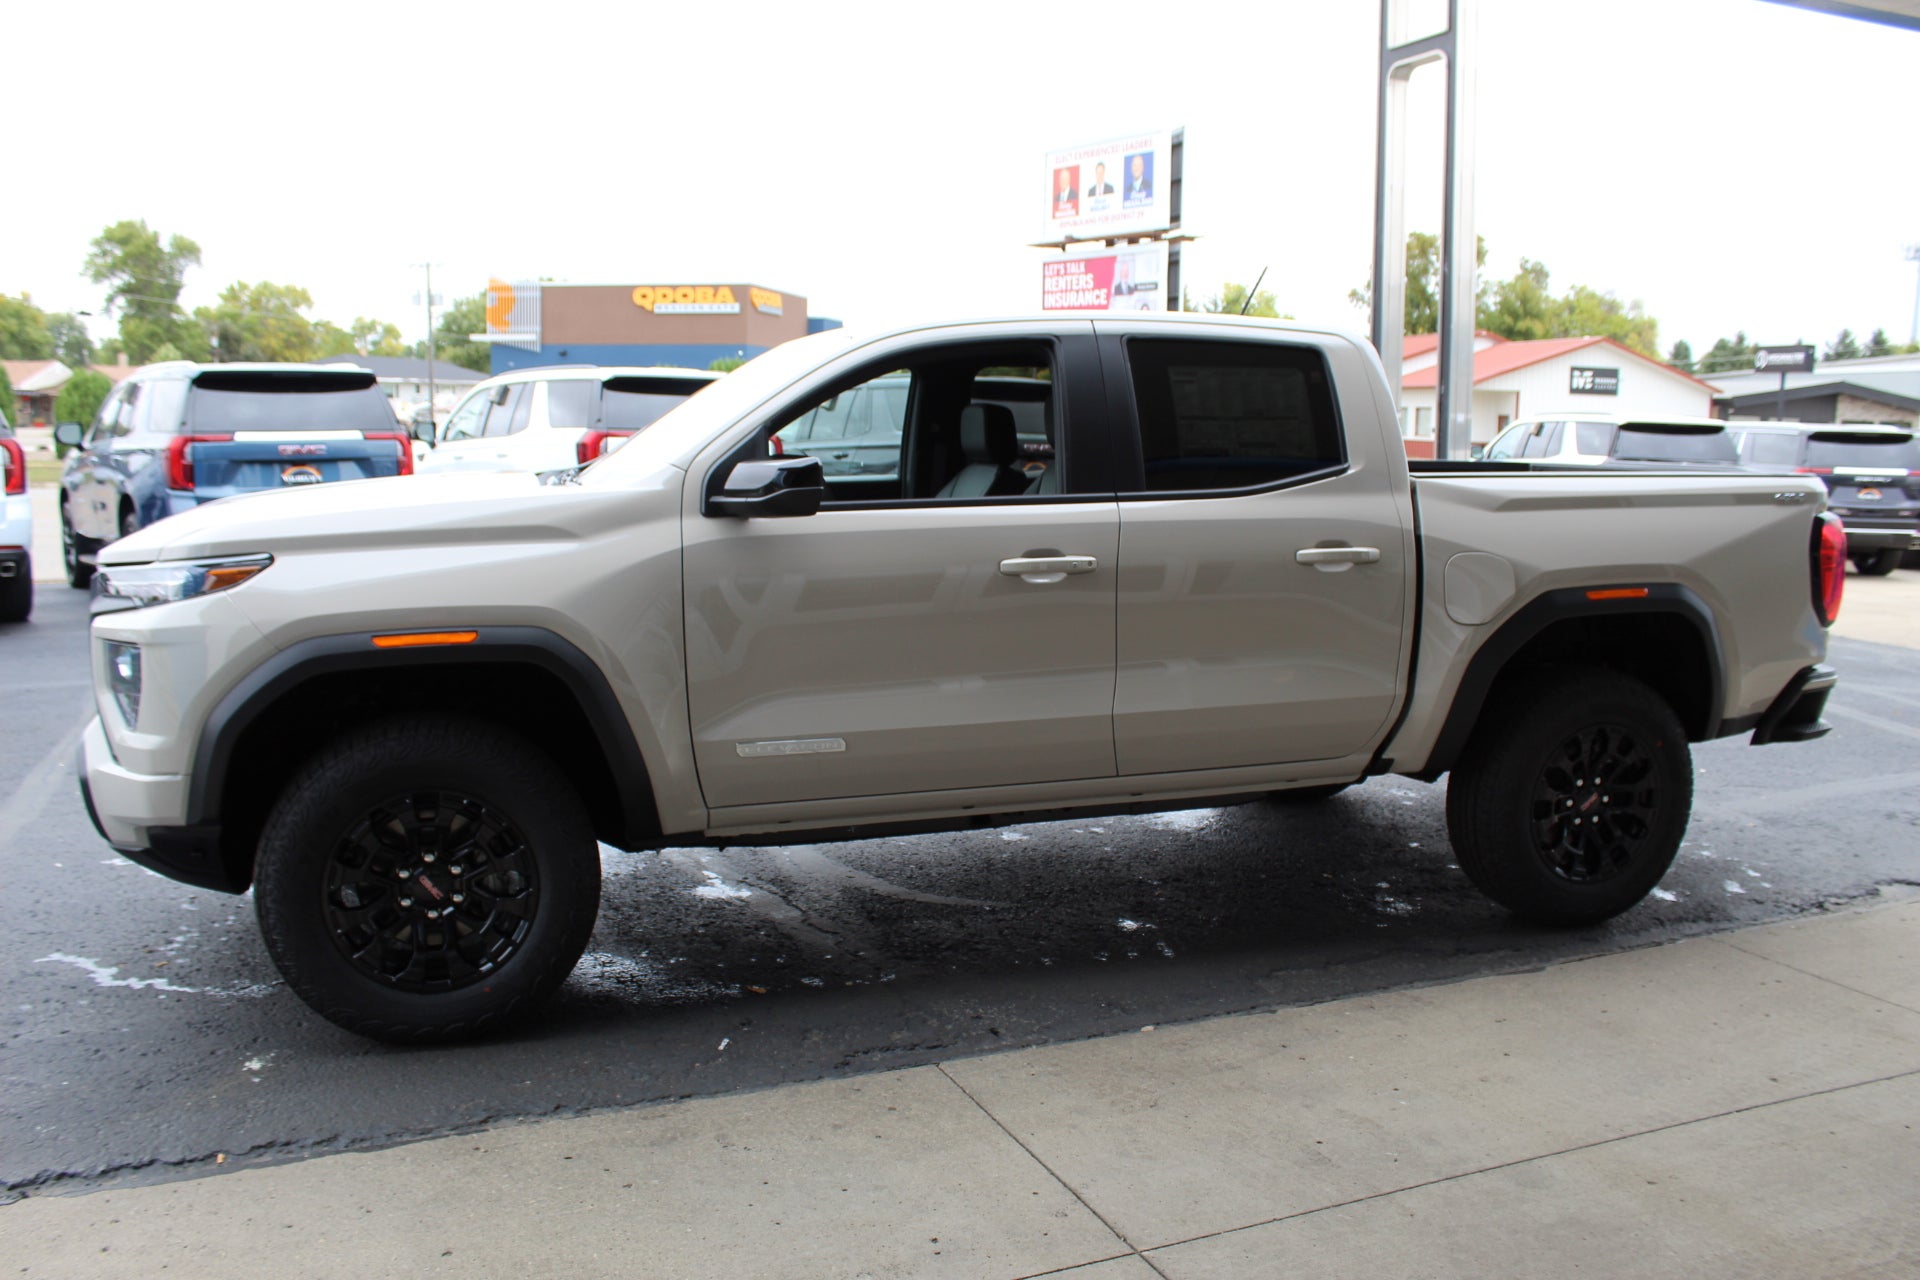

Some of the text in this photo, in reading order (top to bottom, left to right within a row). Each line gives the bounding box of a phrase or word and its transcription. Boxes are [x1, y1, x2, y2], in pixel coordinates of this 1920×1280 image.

[1044, 260, 1086, 276] LET'S TALK
[1044, 272, 1094, 291] RENTERS
[632, 286, 736, 312] QDOBA
[1044, 288, 1108, 308] INSURANCE
